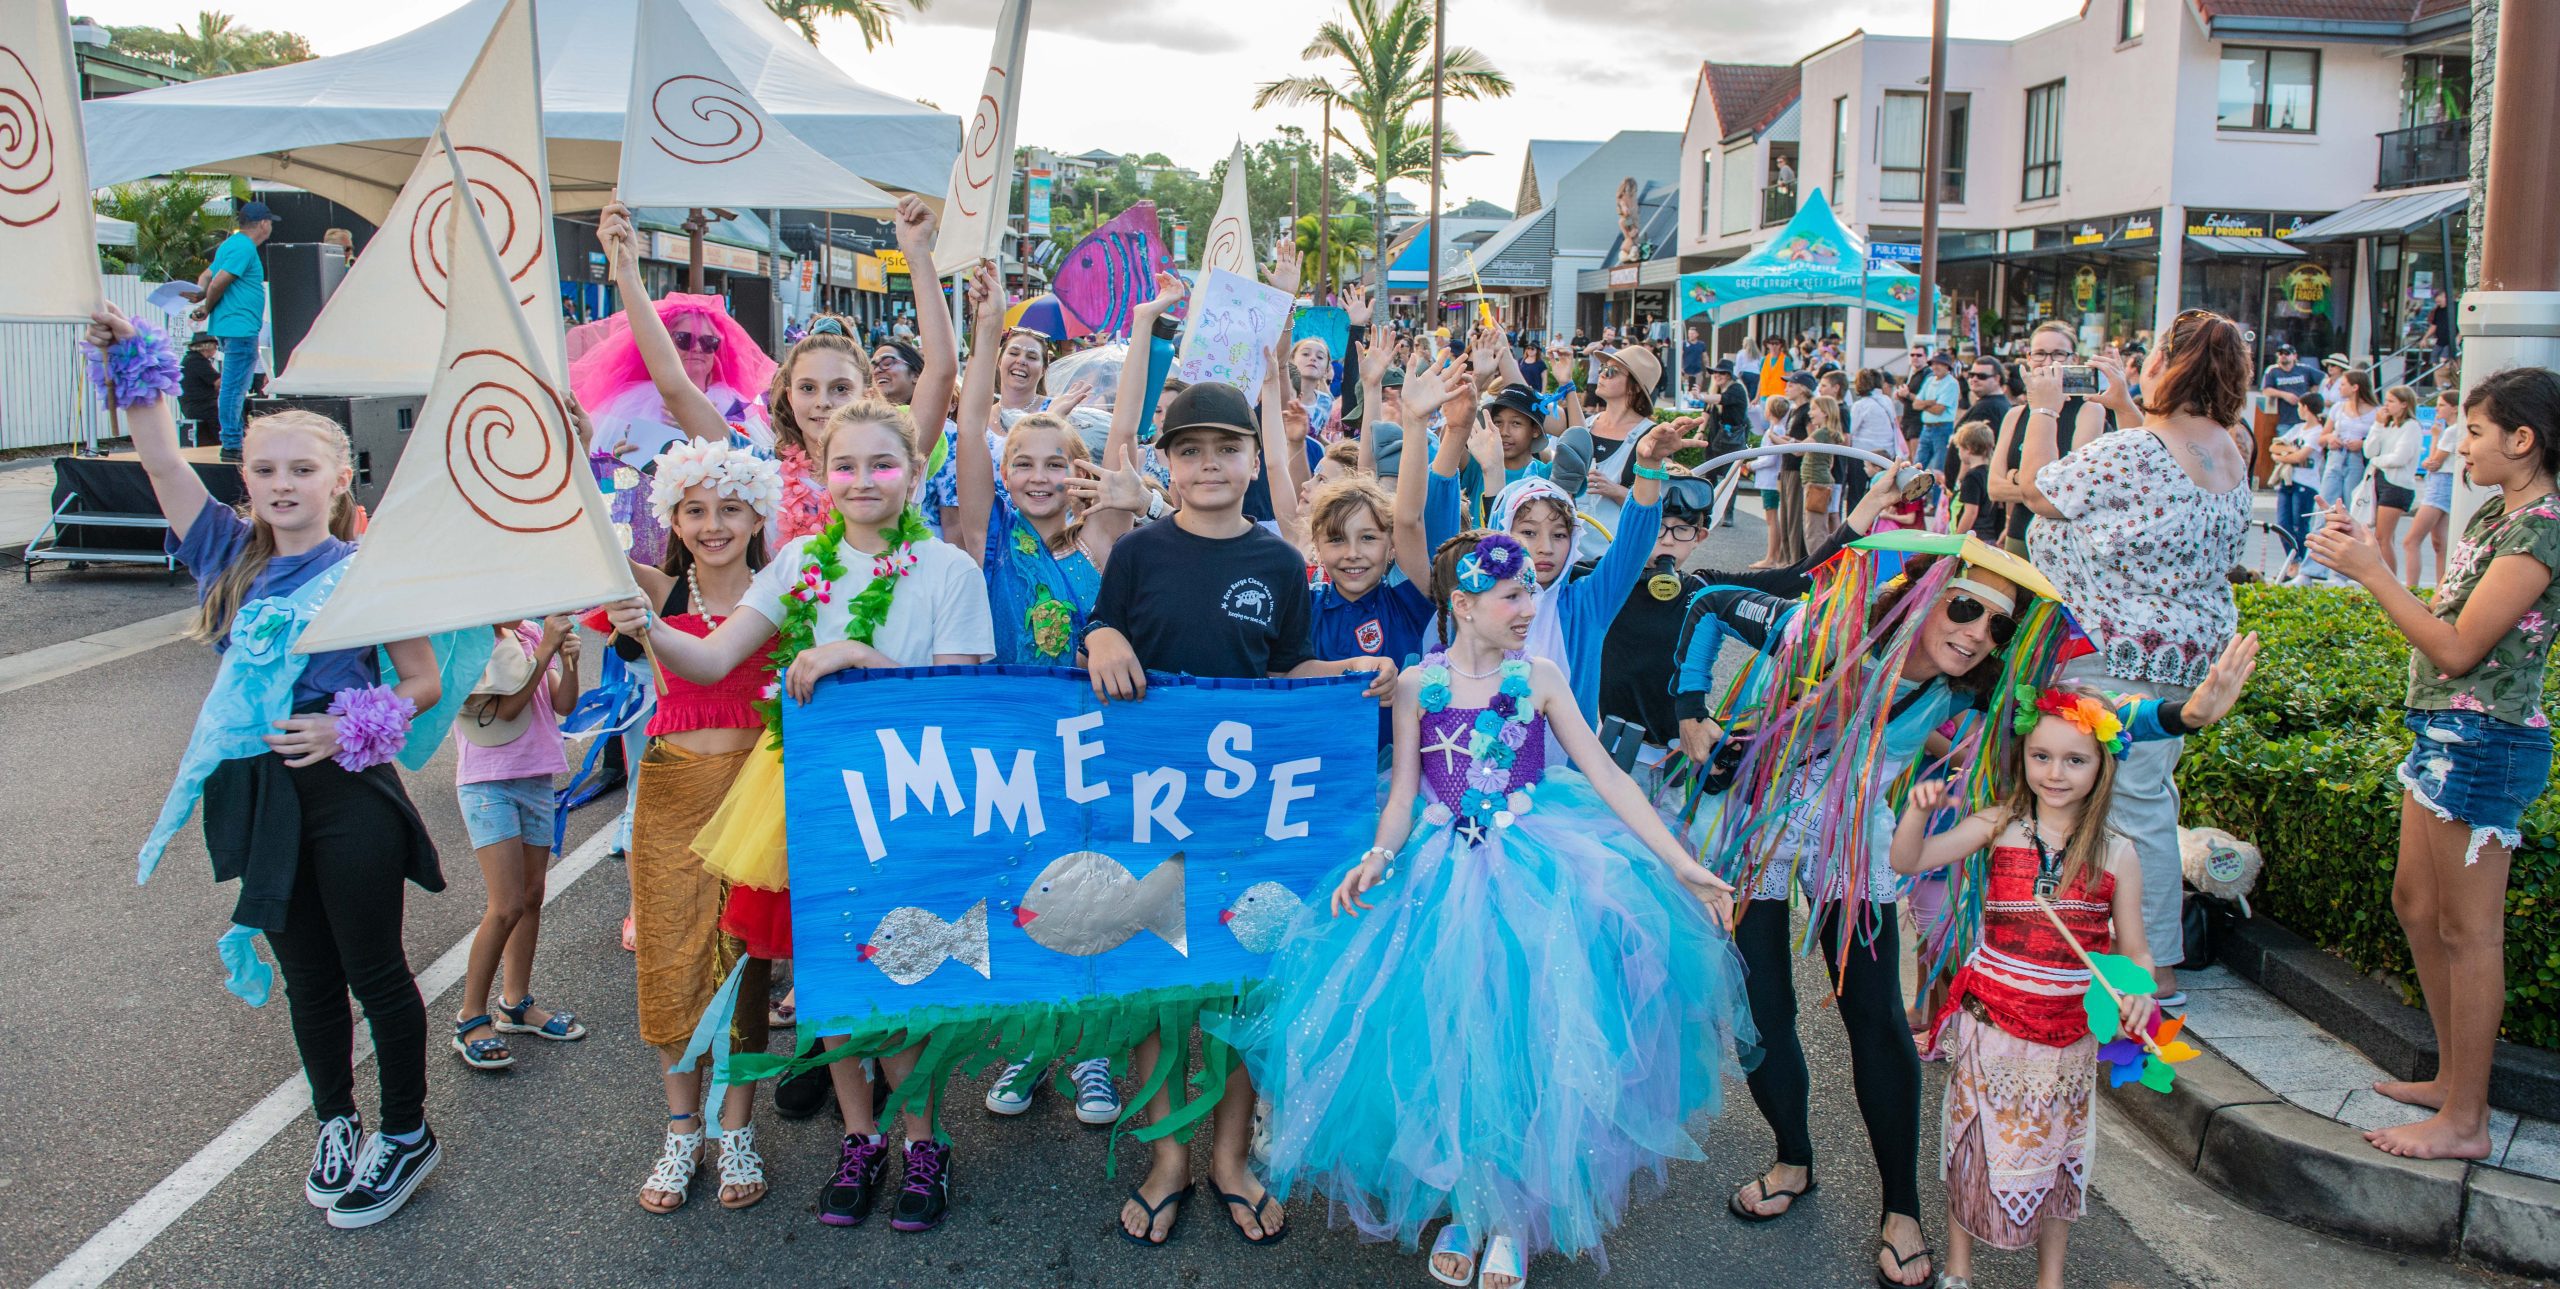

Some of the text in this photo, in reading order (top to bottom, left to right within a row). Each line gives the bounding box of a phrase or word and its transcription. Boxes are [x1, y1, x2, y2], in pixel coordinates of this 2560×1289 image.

[2204, 213, 2247, 228] Exclusive
[2188, 225, 2213, 236] BODY
[2215, 227, 2263, 237] PRODUCTS
[1875, 244, 1897, 255] PUBLIC
[1735, 275, 1862, 289] GREAT BARRIER REEF FESTIVA
[1223, 589, 1233, 600] Eco
[1230, 578, 1248, 590] Barge
[1247, 577, 1264, 588] Clean
[1263, 585, 1273, 600] Seas
[842, 709, 1322, 863] IMMERSE
